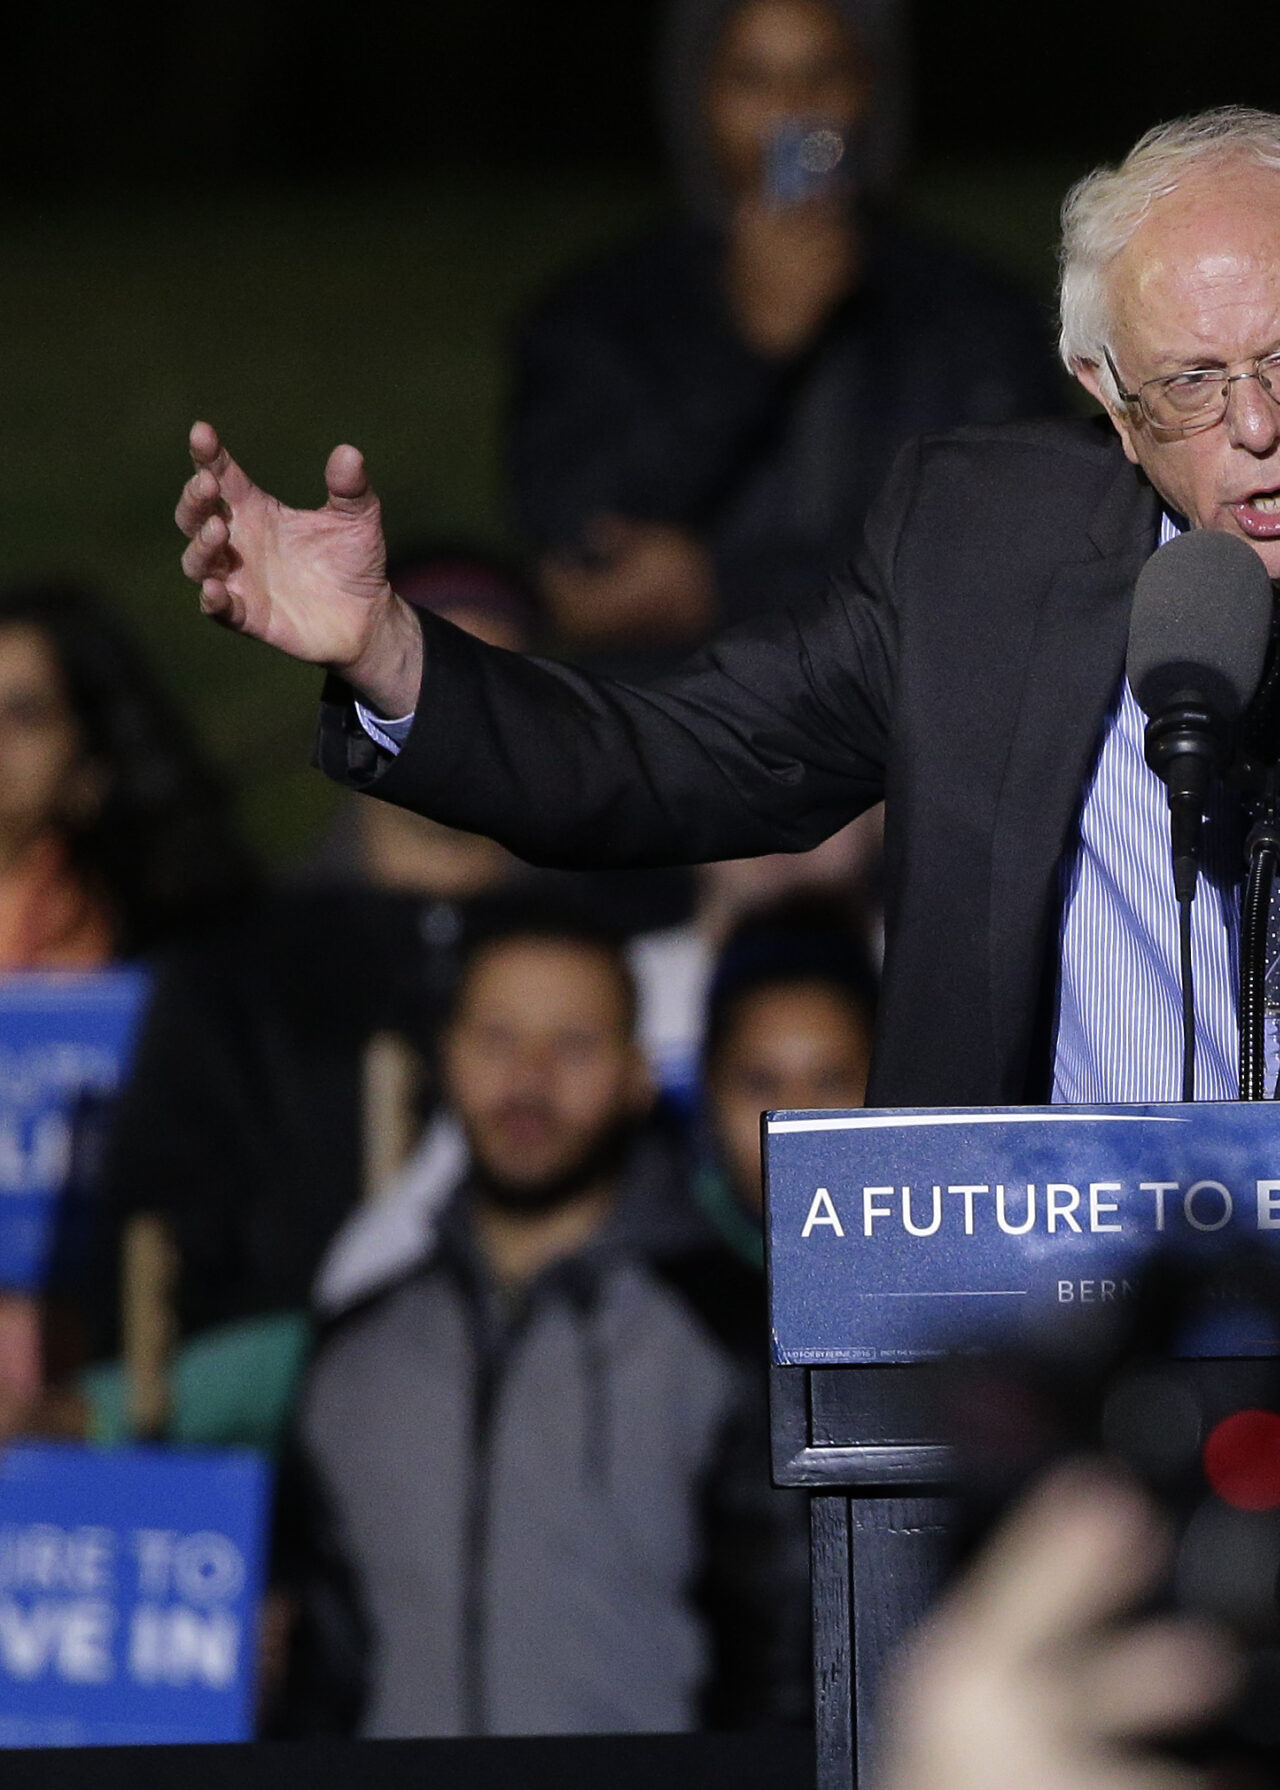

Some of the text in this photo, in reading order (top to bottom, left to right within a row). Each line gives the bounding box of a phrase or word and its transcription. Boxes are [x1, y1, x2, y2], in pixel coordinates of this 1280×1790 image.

[801, 1188, 845, 1237] A
[862, 1181, 1123, 1237] FUTURE
[1139, 1179, 1233, 1232] TO
